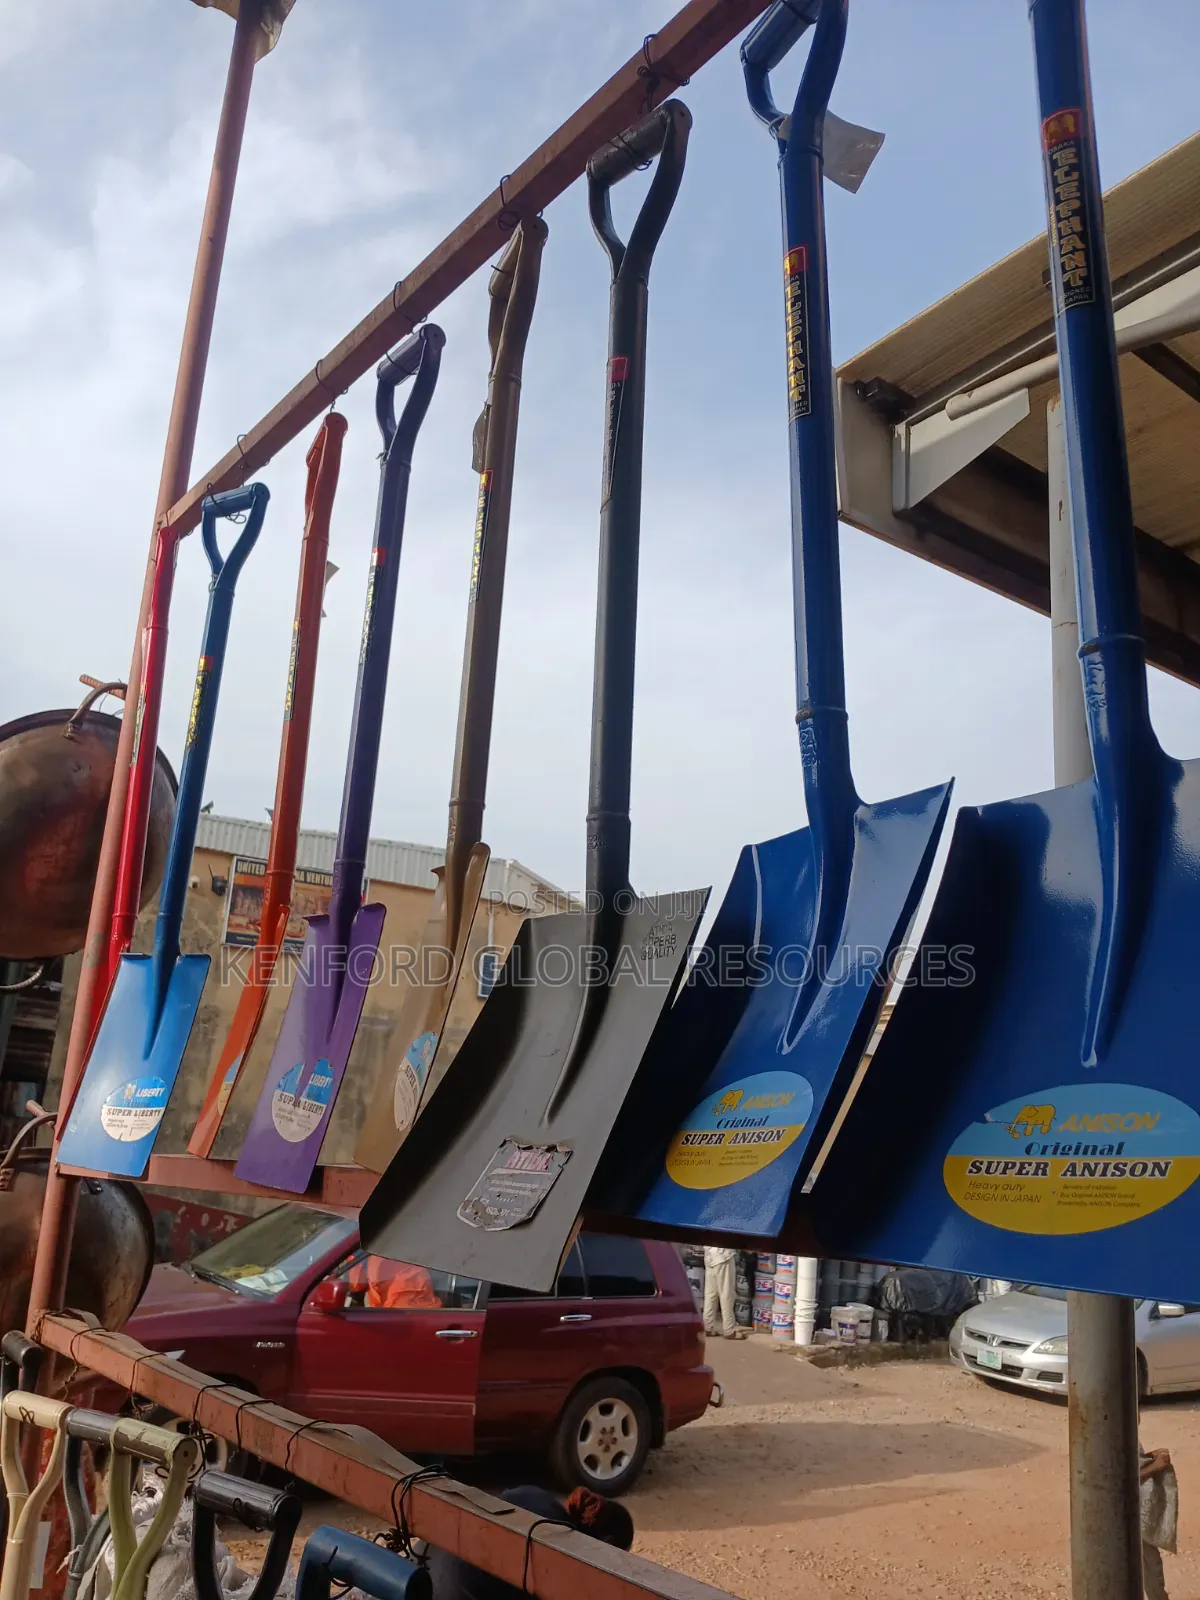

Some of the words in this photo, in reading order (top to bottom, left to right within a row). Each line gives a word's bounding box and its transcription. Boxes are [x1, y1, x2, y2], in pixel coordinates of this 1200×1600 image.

[1053, 147, 1088, 287] ELEPHANT
[237, 861, 265, 876] UNITED
[742, 1092, 795, 1110] ANISON
[107, 1108, 132, 1117] SUPER
[134, 1109, 162, 1118] LIBERTY
[716, 1115, 770, 1130] Original
[1058, 1112, 1160, 1132] ANISON
[680, 1132, 726, 1146] SUPER
[727, 1129, 786, 1144] ANISON
[1024, 1141, 1125, 1156] Original
[966, 1159, 1050, 1177] SUPER
[1060, 1160, 1173, 1178] ANISON
[968, 1181, 1000, 1191] Heavy
[964, 1192, 998, 1202] DESIGN
[1010, 1194, 1042, 1204] JAPAN
